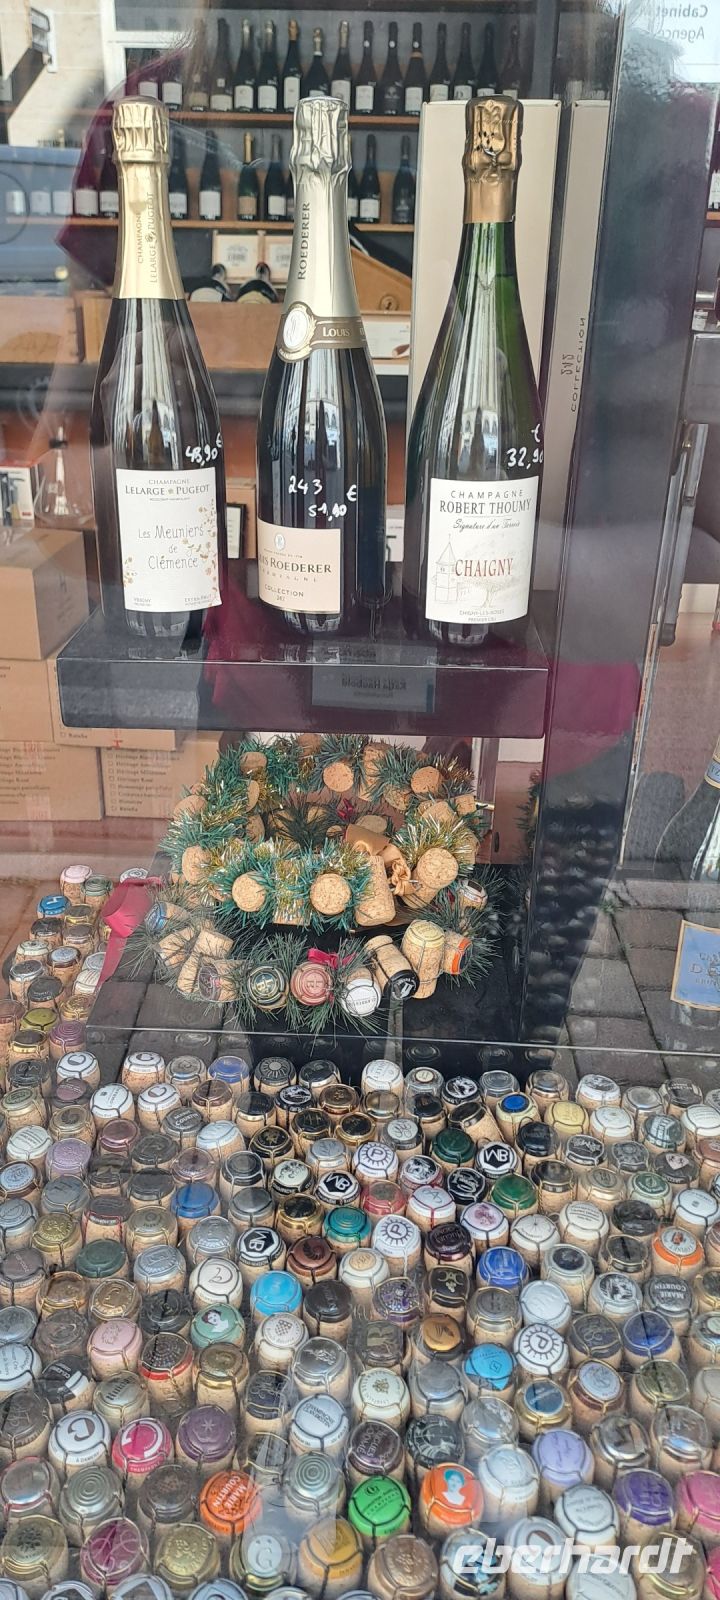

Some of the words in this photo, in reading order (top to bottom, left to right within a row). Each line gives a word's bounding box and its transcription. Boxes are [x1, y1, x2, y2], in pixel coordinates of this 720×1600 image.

[297, 202, 311, 280] ROEDERER
[125, 485, 166, 496] LELARGE
[176, 483, 211, 495] PUGEOT
[288, 475, 323, 495] 243
[450, 489, 523, 499] CHAMPAGNE
[439, 499, 485, 515] ROBERT
[488, 497, 532, 515] THOUMY
[138, 527, 151, 539] Les
[154, 523, 204, 539] Meuniers
[168, 543, 178, 553] de
[270, 557, 332, 574] ROEDERER
[454, 558, 513, 577] CHAIGNY
[264, 583, 304, 598] COLLECTION
[654, 1283, 687, 1292] COURTIN
[213, 1475, 241, 1508] COURTIN
[226, 1485, 248, 1509] MARIE
